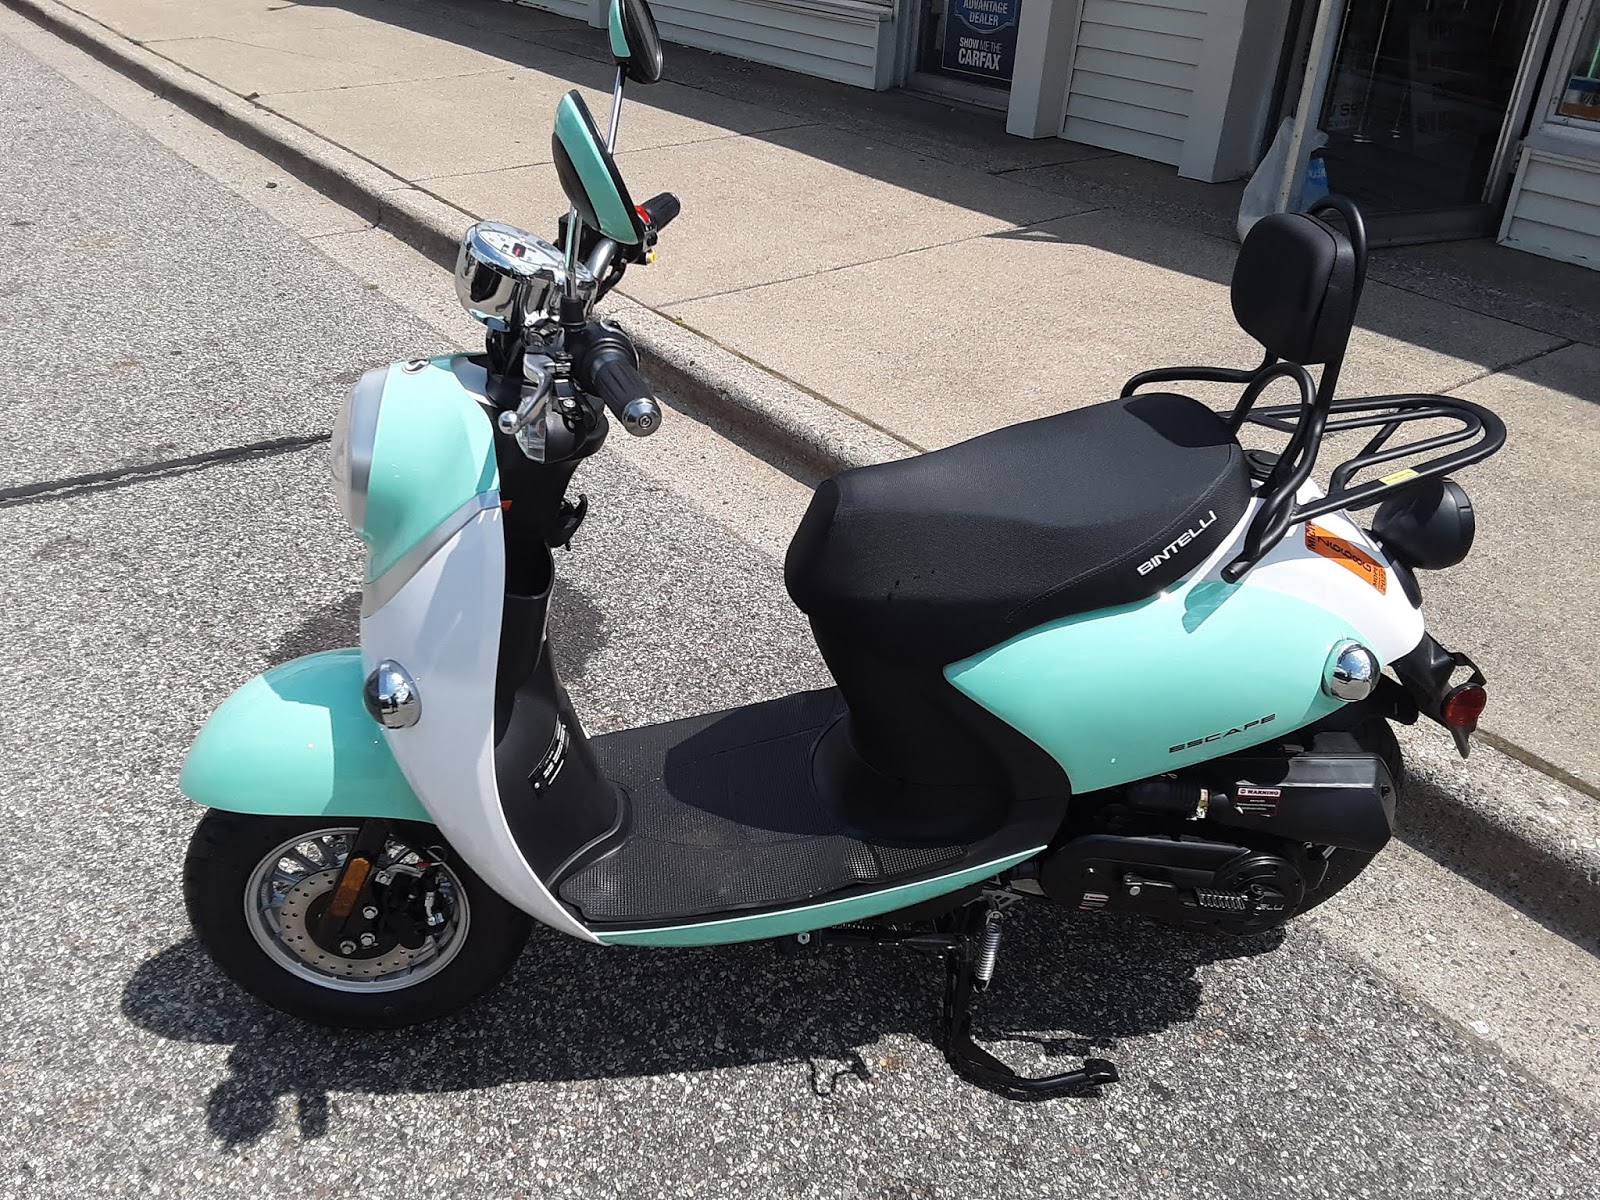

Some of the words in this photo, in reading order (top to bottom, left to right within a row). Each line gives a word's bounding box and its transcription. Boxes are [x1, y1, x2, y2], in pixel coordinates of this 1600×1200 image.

[963, 0, 1008, 14] ADVANTAGE
[970, 11, 999, 26] DEALER
[959, 36, 980, 49] SHOW
[980, 39, 990, 51] ME
[990, 41, 1002, 54] THE
[958, 47, 1001, 70] CARFAX
[1136, 509, 1218, 576] BINTELLI
[1168, 713, 1276, 754] ESCAPE
